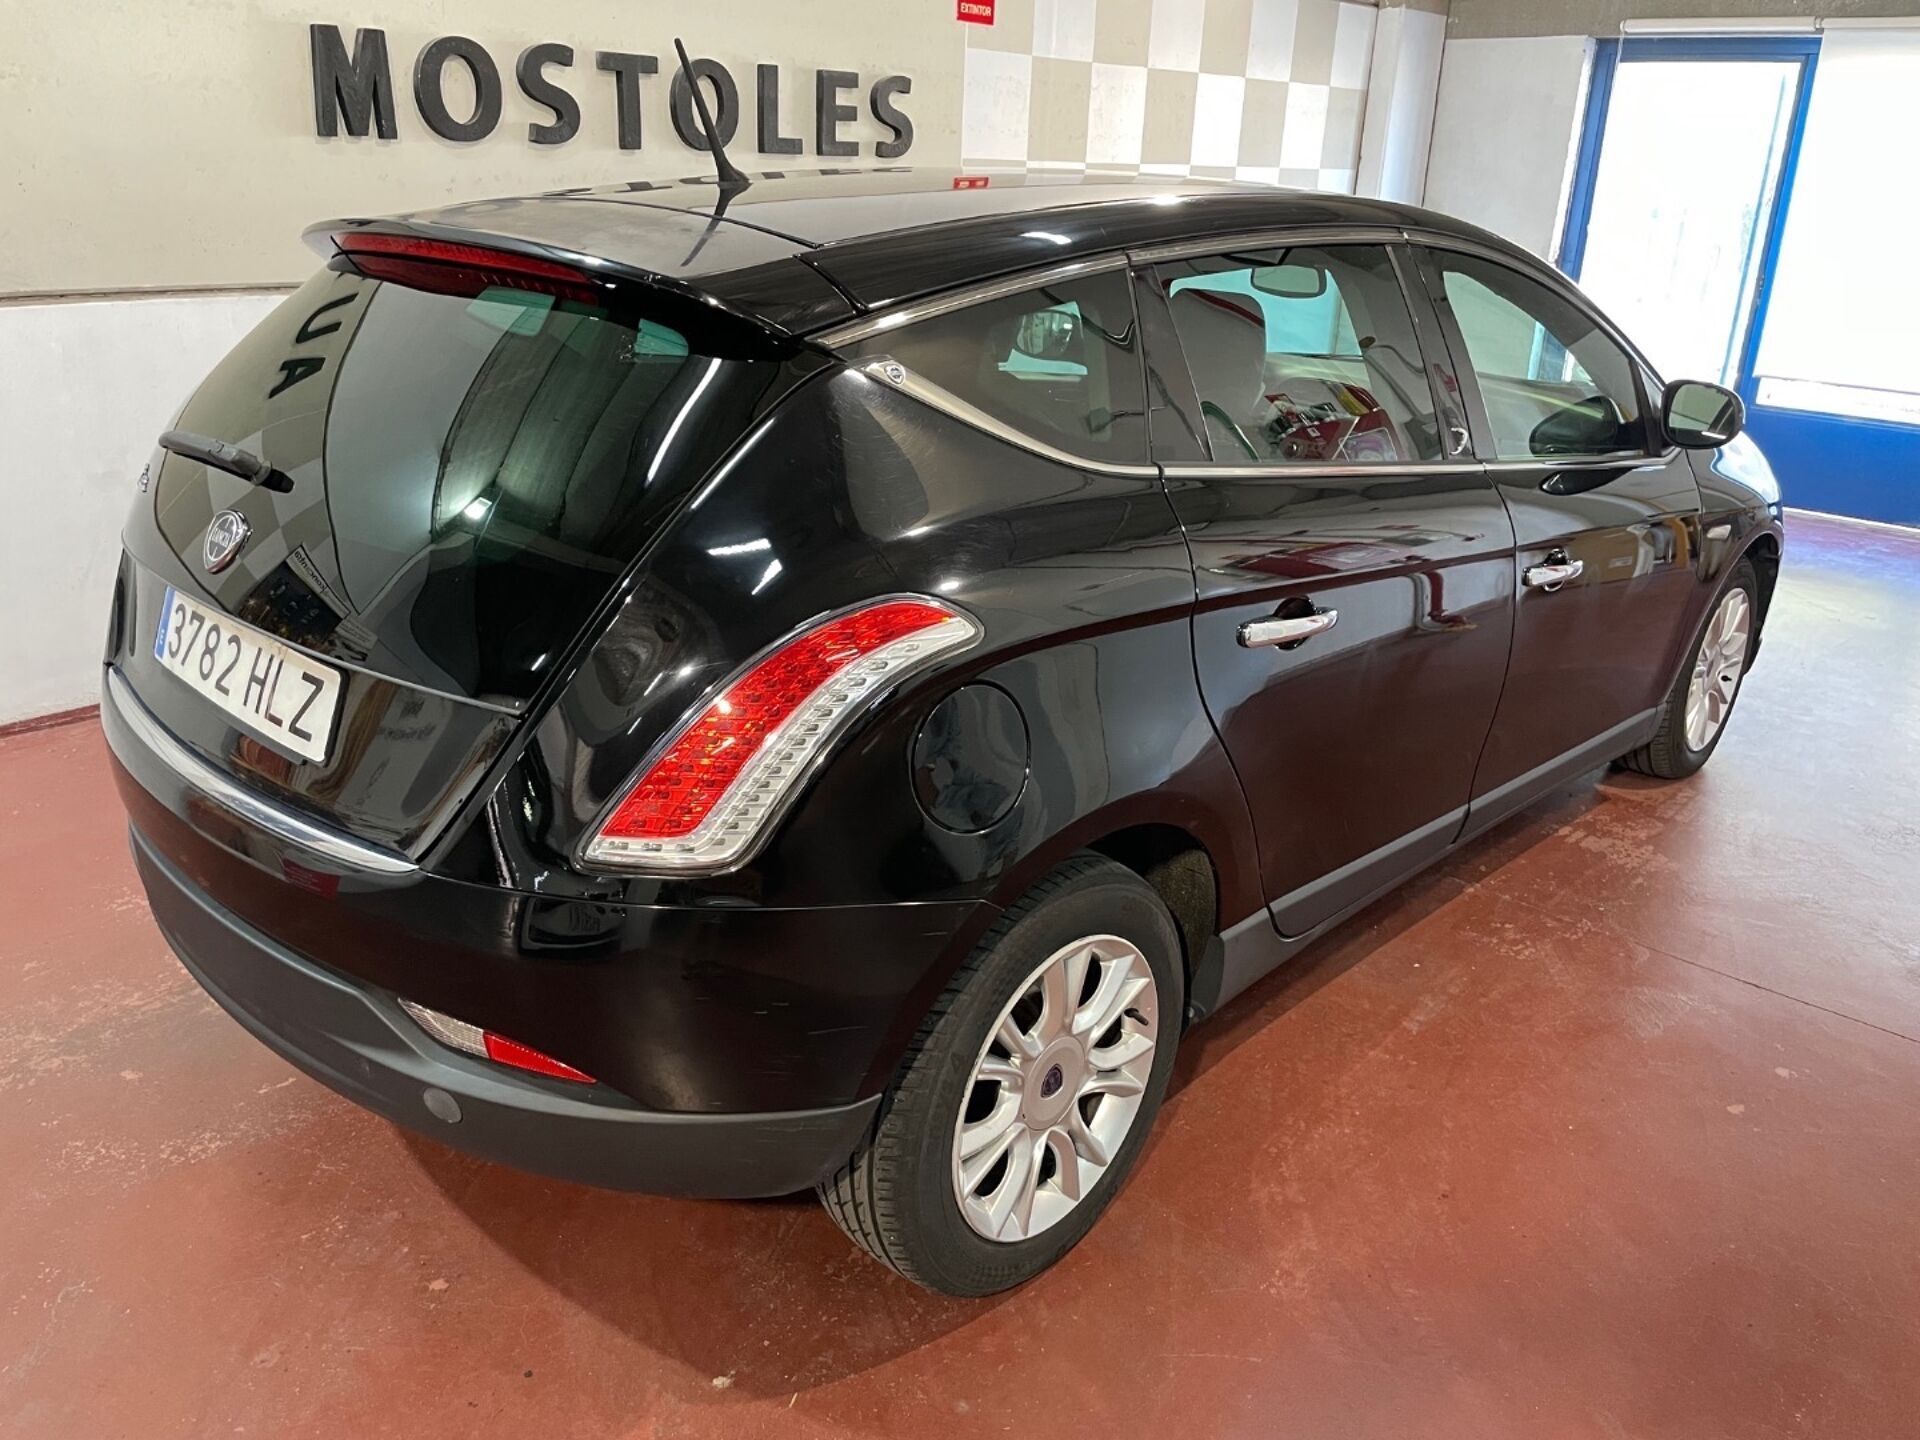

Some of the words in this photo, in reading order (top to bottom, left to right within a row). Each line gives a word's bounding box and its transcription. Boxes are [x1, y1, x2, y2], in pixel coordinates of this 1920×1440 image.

[960, 2, 992, 16] EXTINTOR
[309, 23, 914, 158] MOSTOLES
[168, 603, 242, 697] 3782
[243, 647, 325, 743] HLZ
